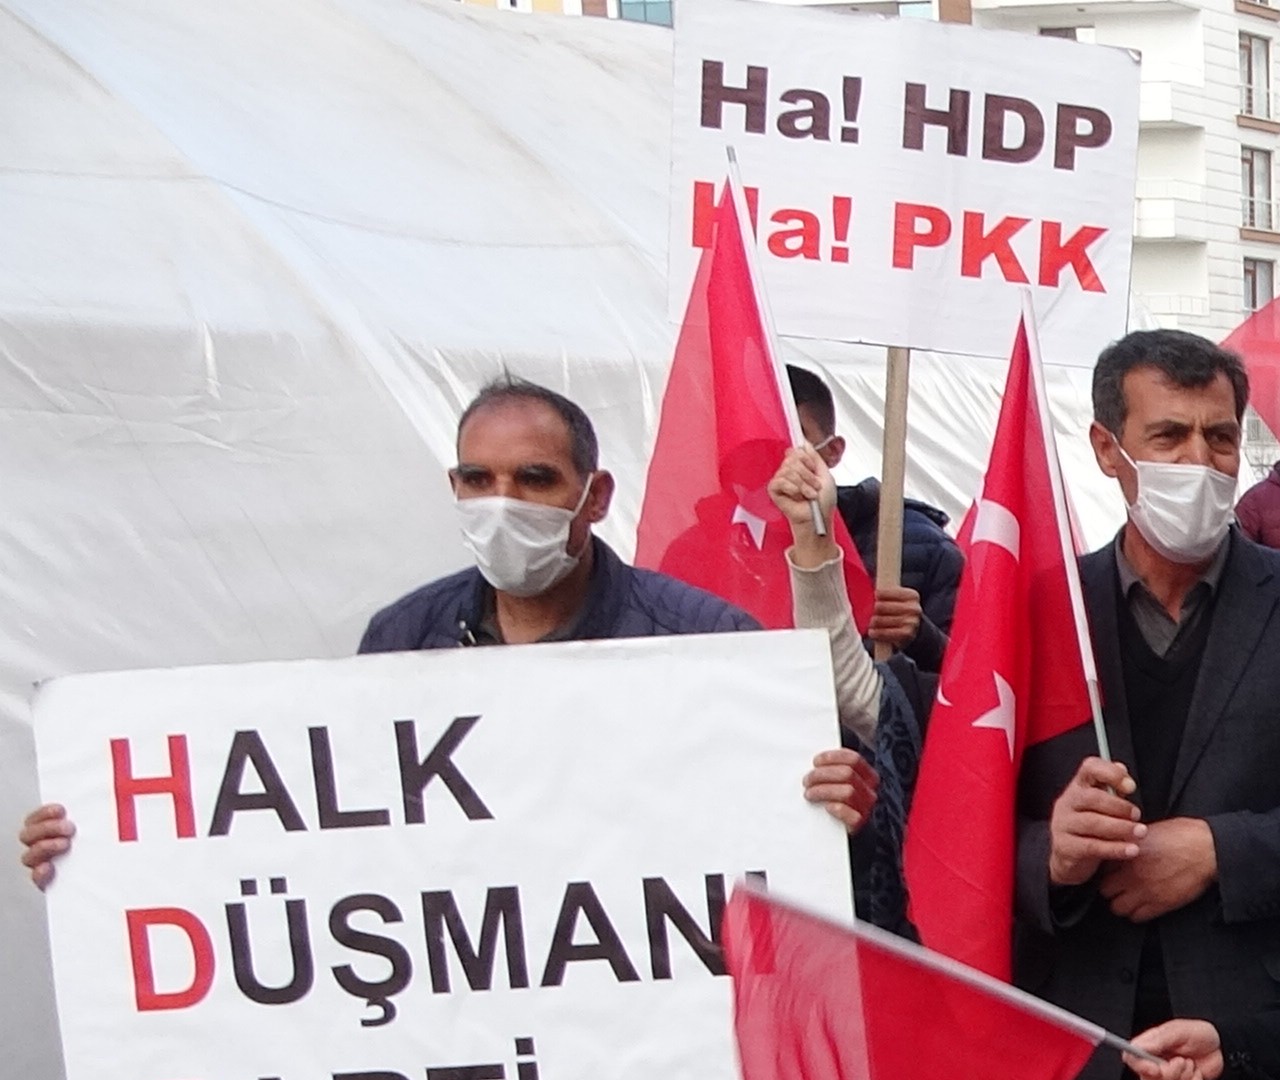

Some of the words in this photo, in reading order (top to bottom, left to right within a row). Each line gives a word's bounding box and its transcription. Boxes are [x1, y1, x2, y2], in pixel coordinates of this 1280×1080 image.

[700, 59, 861, 144] Ha!
[902, 81, 1113, 170] HDP
[892, 201, 1106, 293] PKK
[110, 715, 494, 842] HALK
